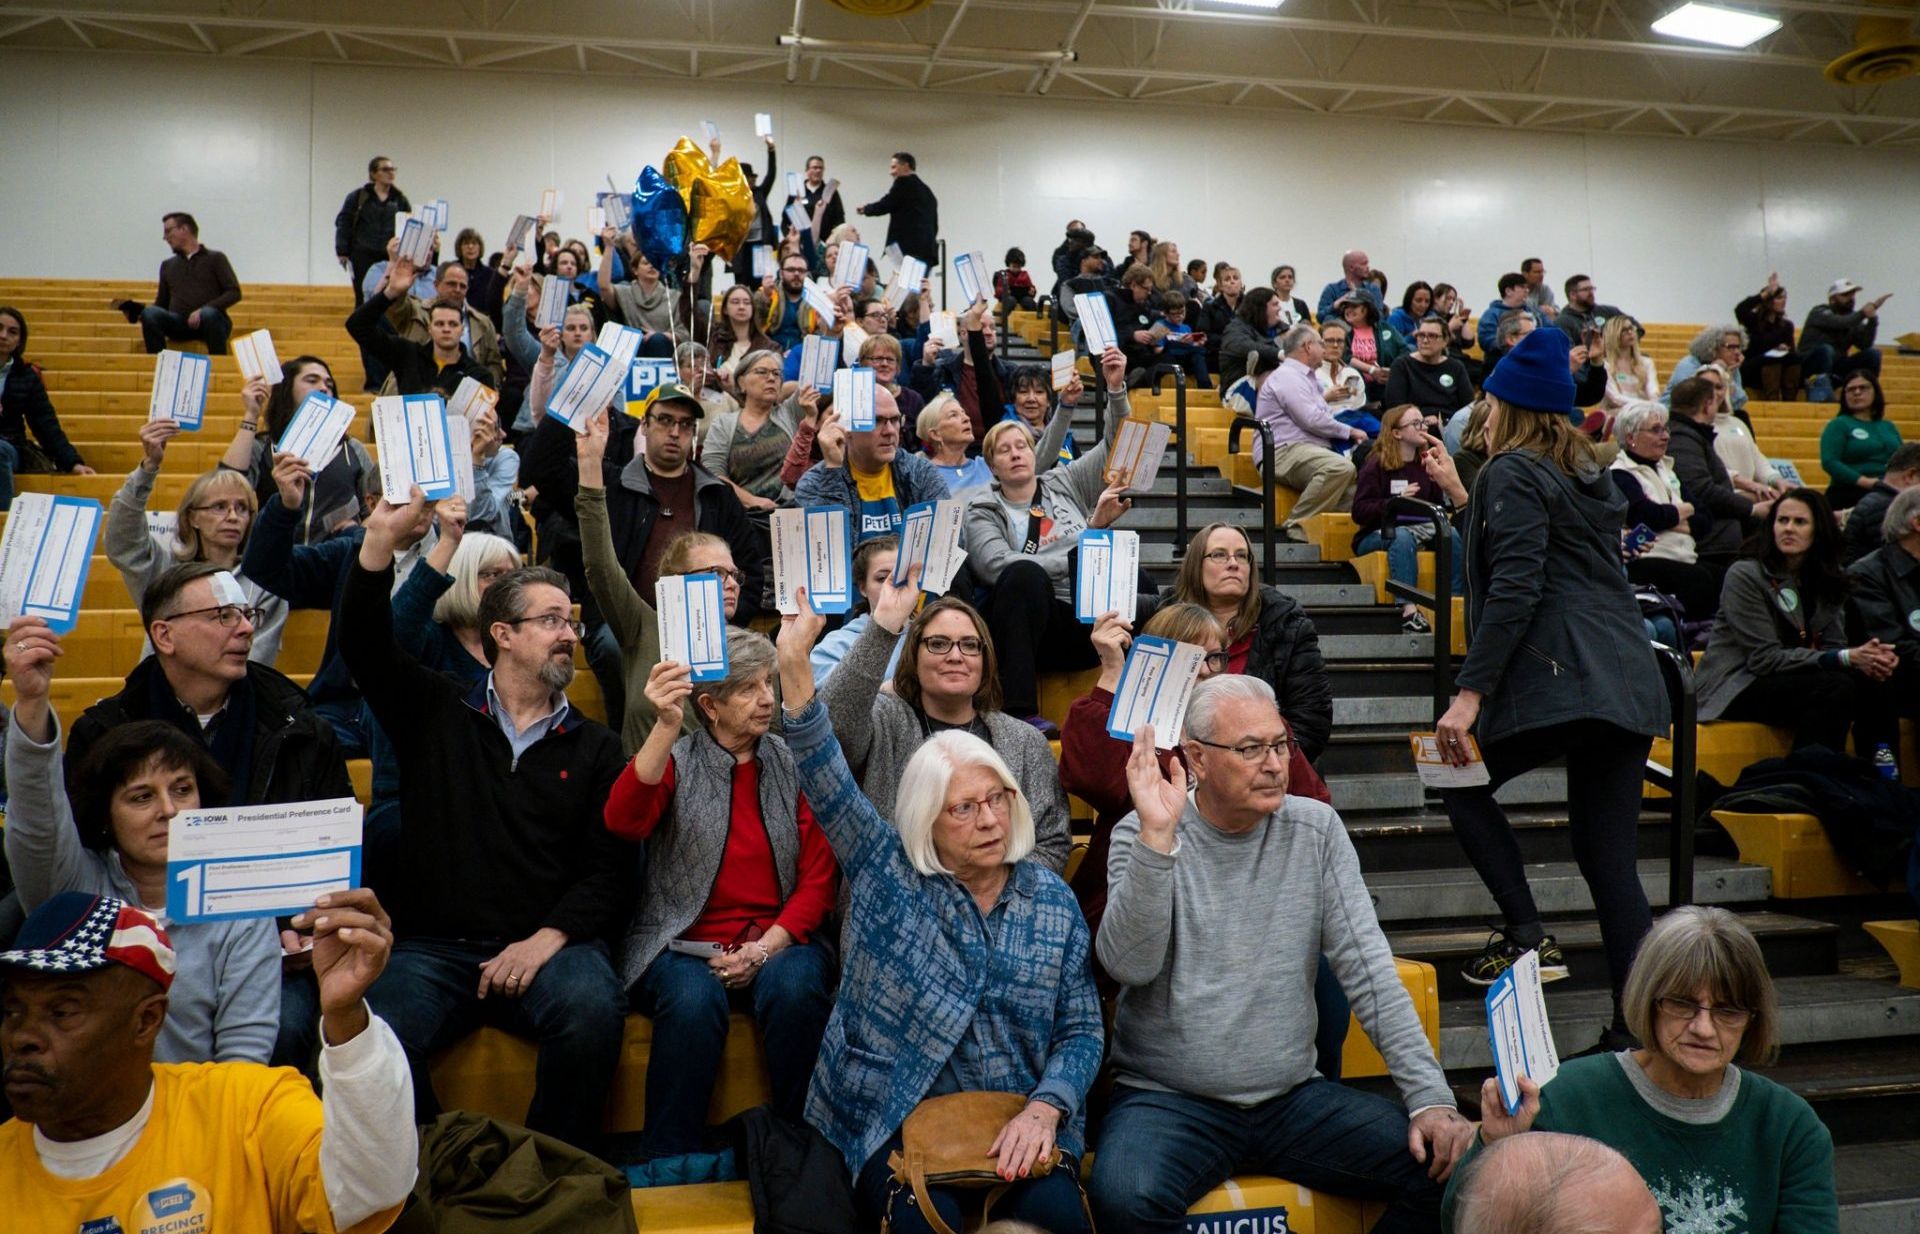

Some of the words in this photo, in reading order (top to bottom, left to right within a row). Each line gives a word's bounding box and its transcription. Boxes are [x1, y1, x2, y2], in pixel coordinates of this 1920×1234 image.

[907, 505, 933, 519] 1
[865, 518, 888, 529] PETE
[1083, 534, 1111, 546] 1
[812, 594, 846, 608] 1
[1137, 643, 1170, 657] 1
[692, 663, 724, 677] 1
[1180, 677, 1191, 702] Presidential
[1172, 703, 1182, 729] Preference
[204, 814, 228, 823] IOWA
[237, 812, 288, 822] Presidential
[289, 806, 332, 819] Preference
[333, 805, 351, 814] Card
[176, 864, 201, 917] 1
[1490, 976, 1514, 1010] 1
[1535, 990, 1543, 1024] Presidential
[1541, 1024, 1551, 1054] Preference
[1547, 1055, 1555, 1069] Card
[141, 1213, 205, 1234] PRECINCT
[1186, 1214, 1287, 1234] AUCUS
